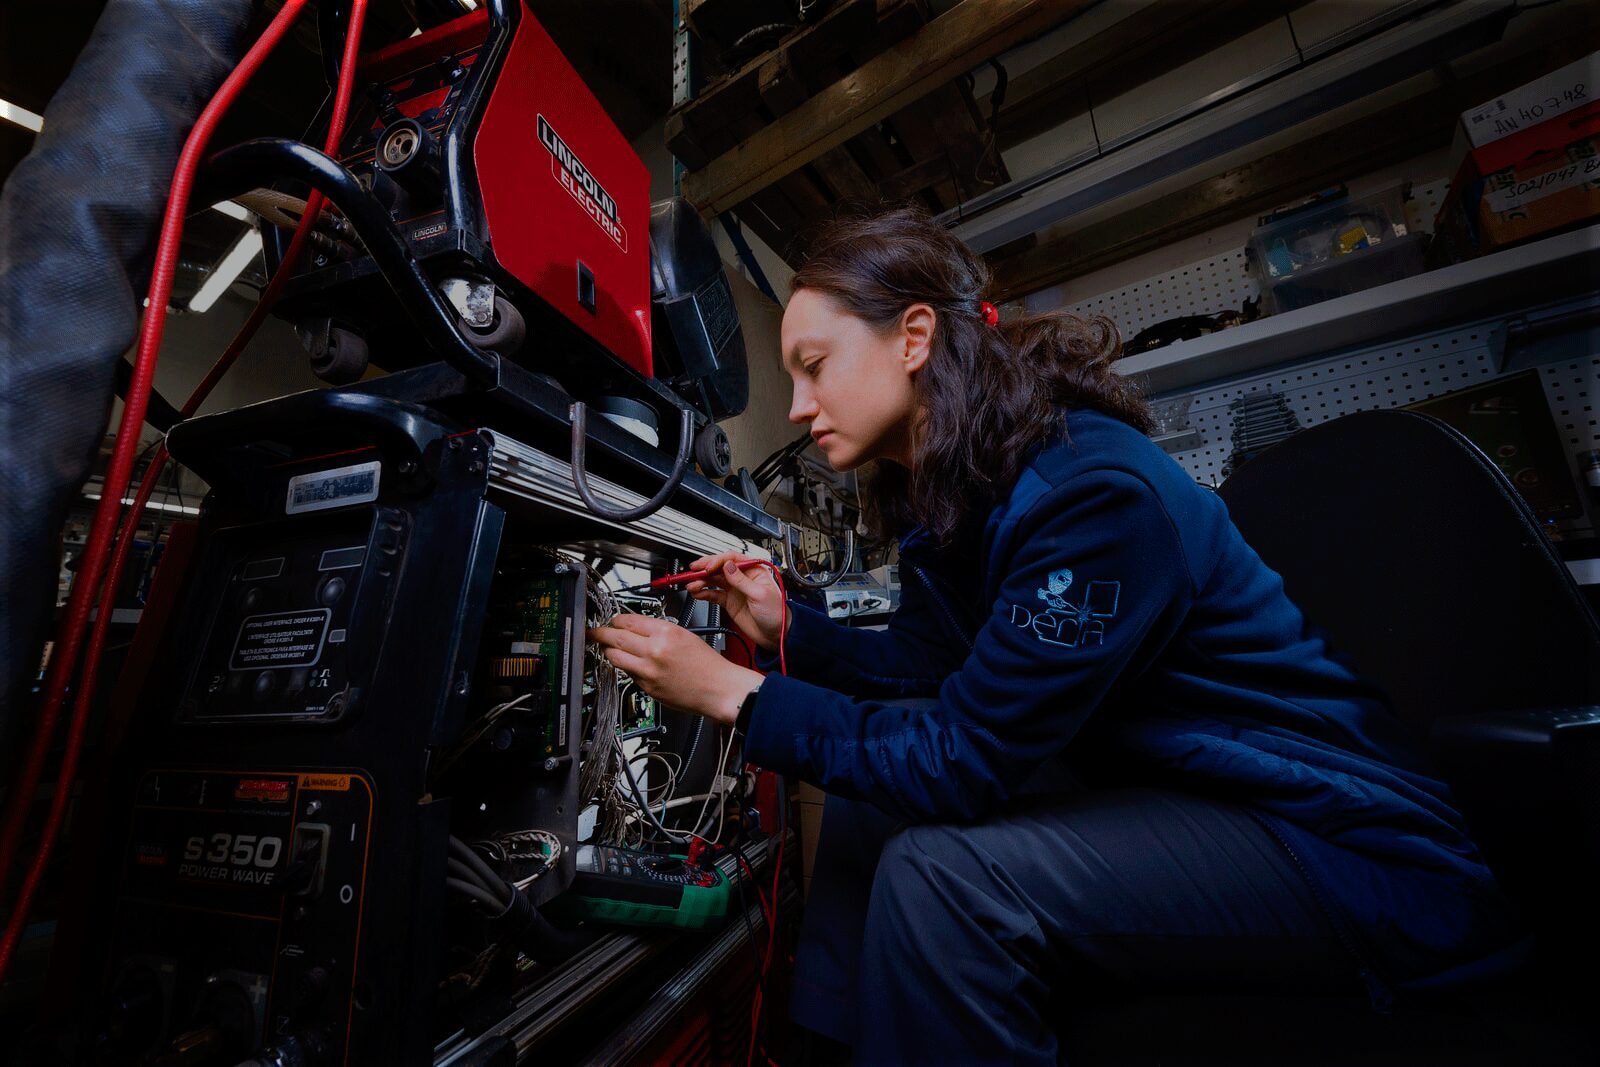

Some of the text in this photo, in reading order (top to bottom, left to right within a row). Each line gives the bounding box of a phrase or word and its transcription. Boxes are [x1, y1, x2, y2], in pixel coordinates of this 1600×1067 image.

[542, 122, 614, 219] LINCOLN
[560, 167, 622, 244] ELECTRIC
[414, 225, 444, 238] LINCOLN
[179, 863, 275, 885] POWER WAVE
